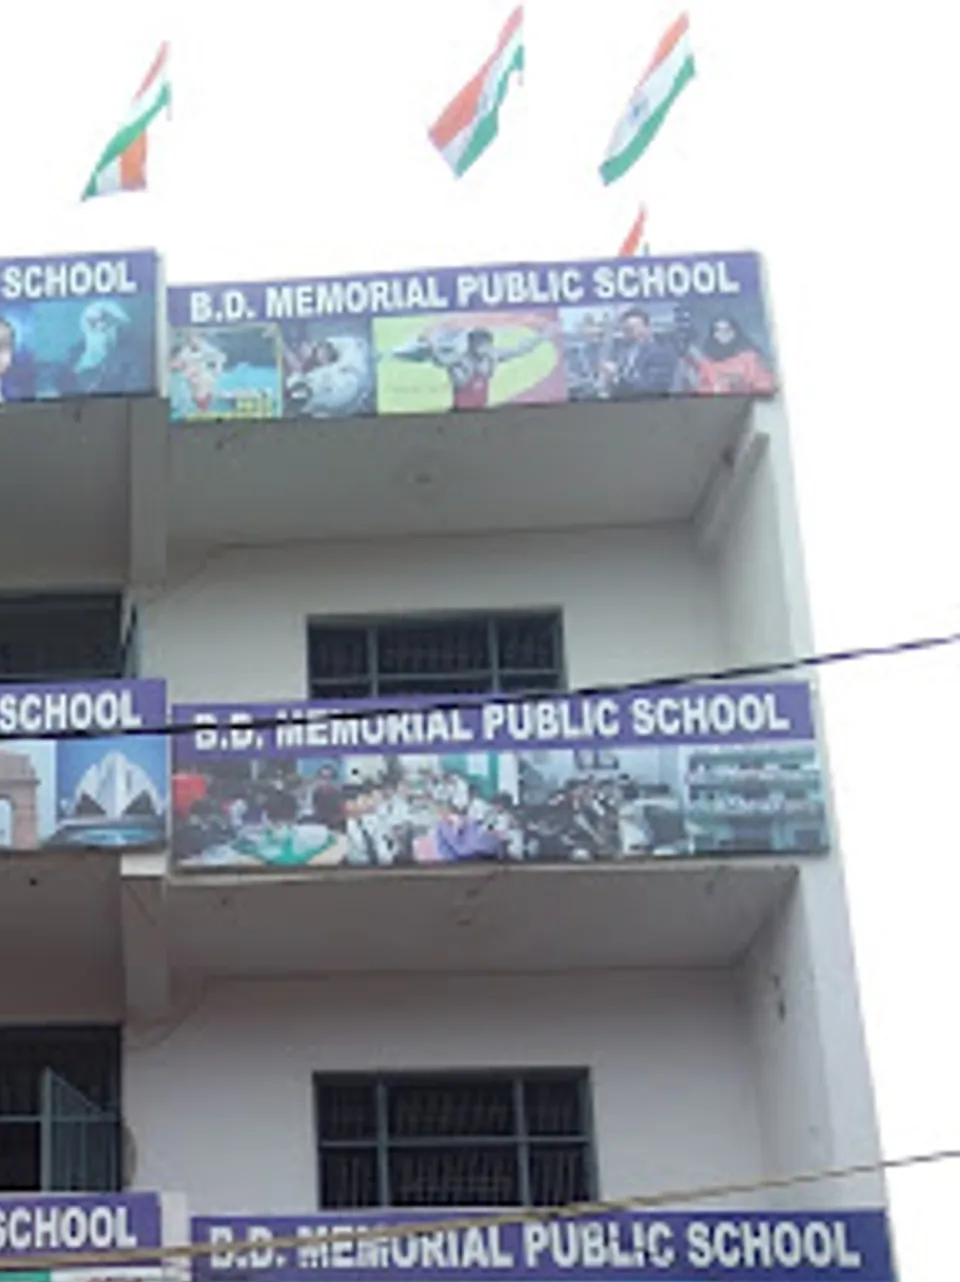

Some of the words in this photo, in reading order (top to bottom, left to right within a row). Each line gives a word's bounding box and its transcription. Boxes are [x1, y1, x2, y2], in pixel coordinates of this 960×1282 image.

[1, 258, 137, 300] SCHOOL
[189, 290, 256, 322] B.D.
[265, 275, 448, 319] MEMORIAL
[456, 267, 584, 306] PUBLIC
[593, 261, 739, 299] SCHOOL
[194, 713, 264, 750] B.D.
[276, 704, 473, 748] MEMORIAL
[482, 699, 620, 740] PUBLIC
[631, 694, 790, 735] SCHOOL
[209, 1226, 286, 1269] B.D.
[297, 1224, 514, 1268] MEMORIAL
[524, 1222, 675, 1268] PUBLIC
[688, 1220, 860, 1267] SCHOOL
